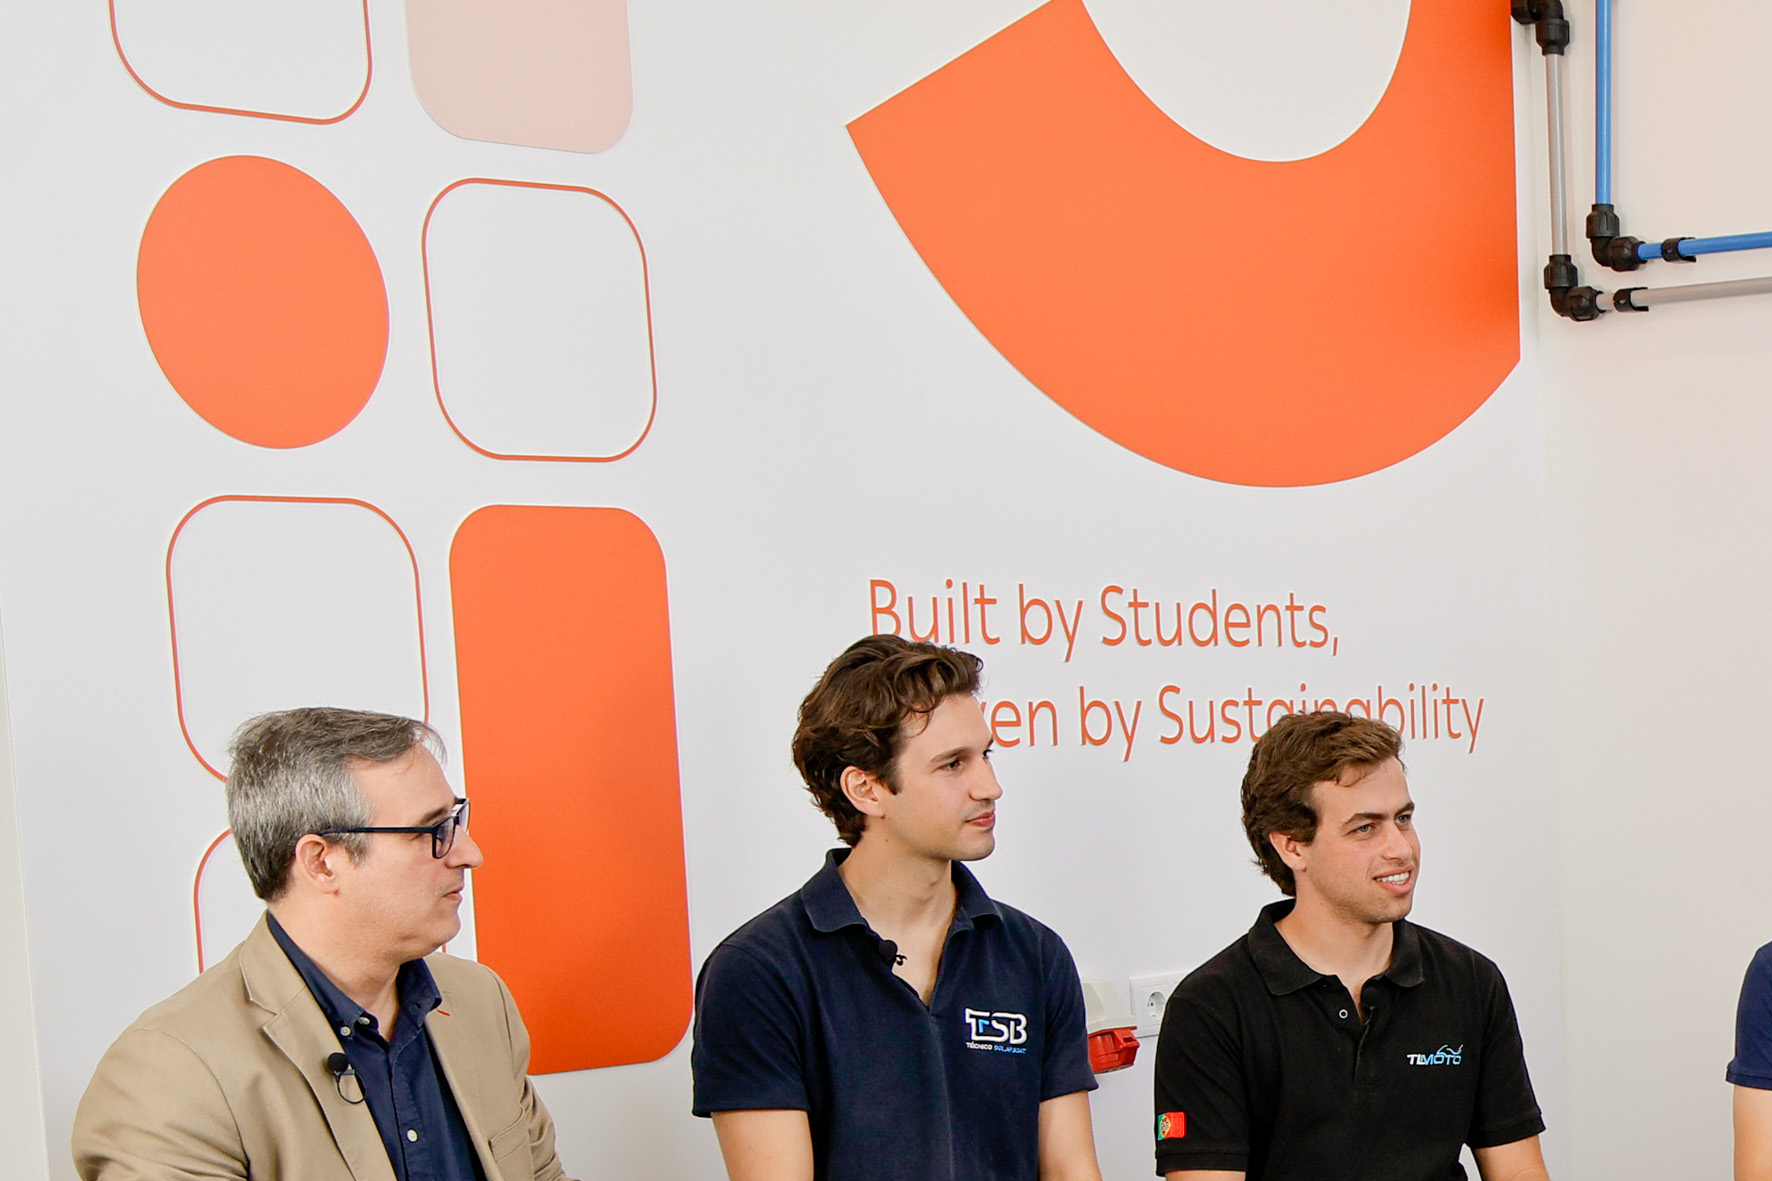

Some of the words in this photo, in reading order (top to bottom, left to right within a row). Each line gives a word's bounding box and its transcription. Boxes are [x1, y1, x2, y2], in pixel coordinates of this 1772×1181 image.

[870, 578, 1001, 645] Built
[1018, 583, 1084, 663] by
[1100, 584, 1339, 657] Students,
[1079, 685, 1142, 762] by
